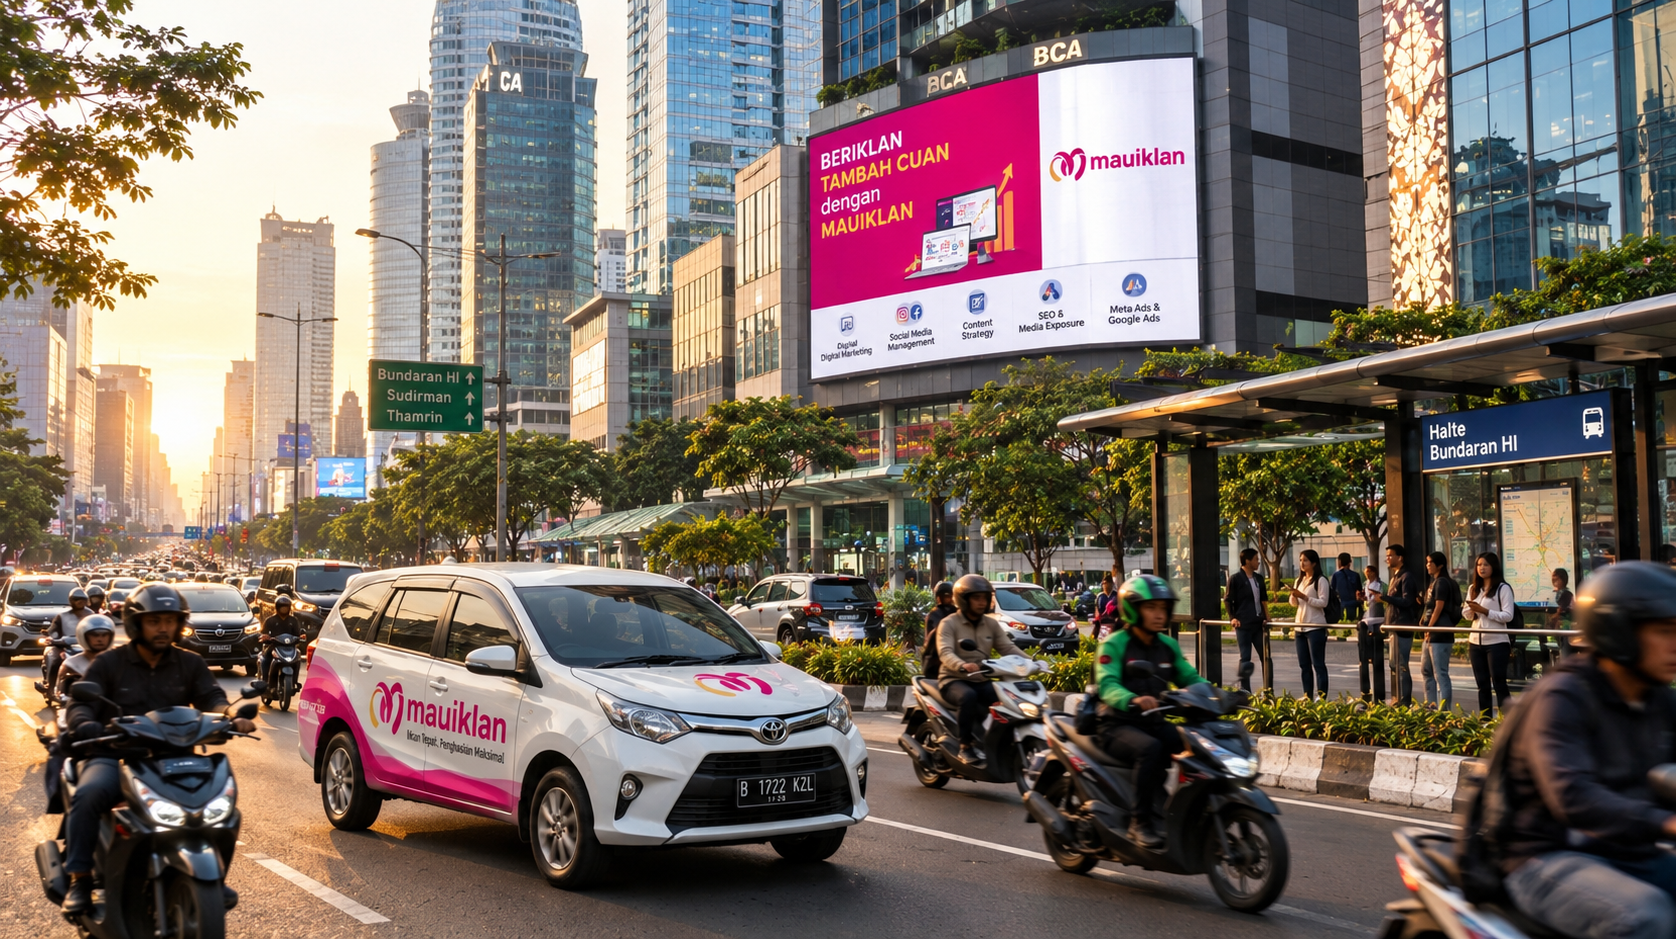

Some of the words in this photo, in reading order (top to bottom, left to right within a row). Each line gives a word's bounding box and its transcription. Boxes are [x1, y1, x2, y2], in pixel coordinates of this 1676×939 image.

[1033, 39, 1083, 67] BCA
[927, 68, 967, 96] BCA
[821, 130, 902, 170] BERIKLAN
[1090, 147, 1185, 170] mauiklan
[820, 158, 891, 192] TAMBAH
[896, 142, 949, 171] CUAN
[821, 188, 880, 215] dengan
[821, 201, 913, 239] MAUIKLAN
[1038, 311, 1055, 320] SEO
[1110, 305, 1132, 314] Meta
[1134, 304, 1151, 312] Ads
[963, 319, 993, 330] Content
[1019, 322, 1044, 333] Media
[1045, 319, 1085, 331] Exposure
[1108, 315, 1140, 325] Google
[1143, 314, 1160, 323] Ads
[889, 331, 909, 341] Social
[911, 328, 932, 337] Media
[961, 329, 994, 340] Strategy
[378, 368, 442, 382] Bundaran
[447, 371, 459, 383] HI
[387, 389, 451, 403] Sudirman
[387, 409, 442, 423] Thamrin
[1429, 421, 1466, 440] Halte
[1430, 440, 1497, 461] Bundaran
[1501, 435, 1517, 452] HI
[407, 700, 506, 744] mauiklan
[740, 781, 748, 797] B
[759, 778, 786, 795] 1722
